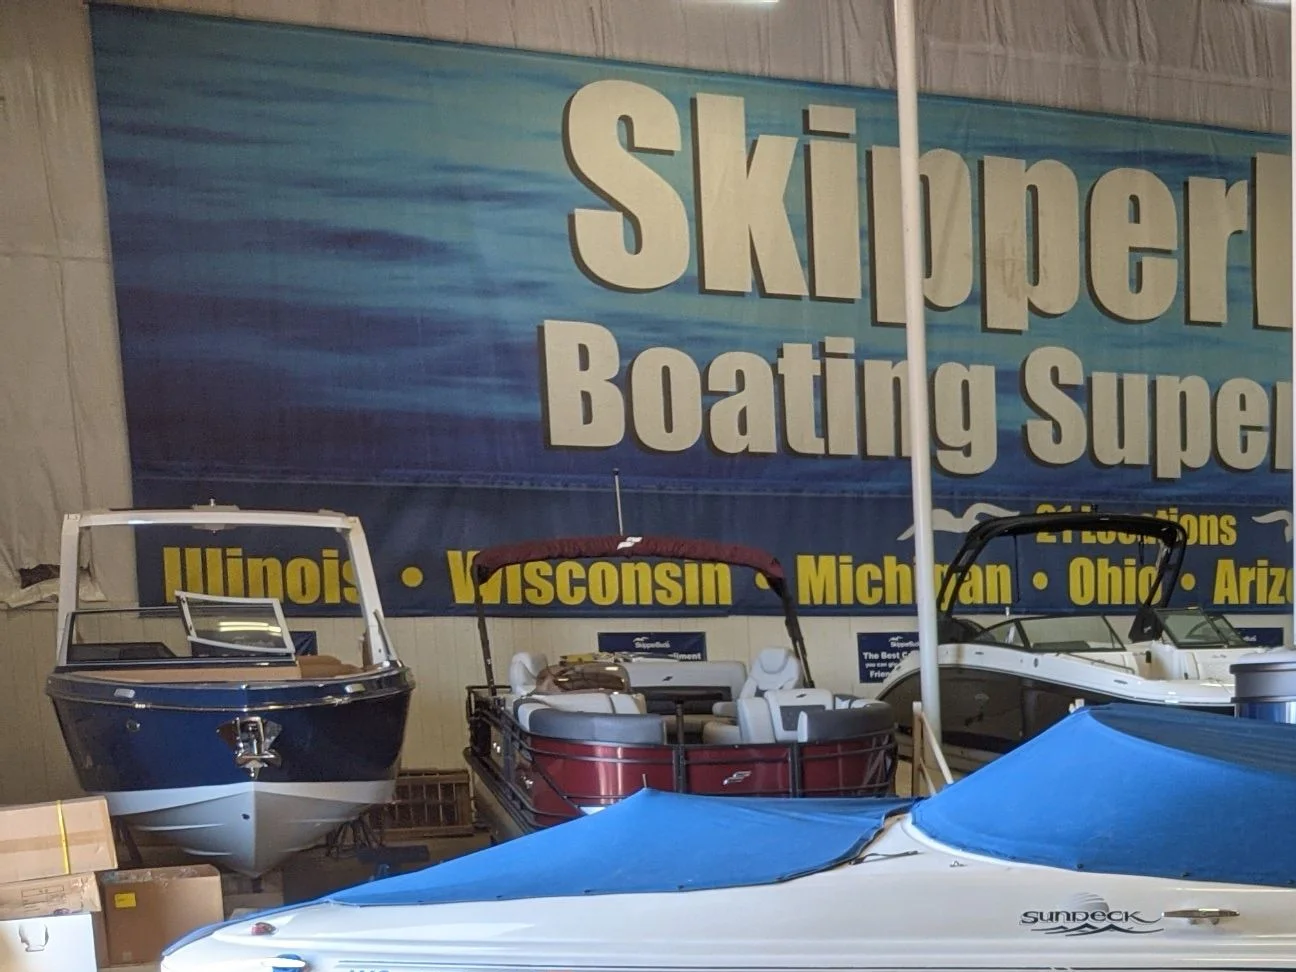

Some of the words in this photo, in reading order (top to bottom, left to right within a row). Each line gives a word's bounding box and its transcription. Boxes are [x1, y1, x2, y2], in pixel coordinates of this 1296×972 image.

[543, 320, 997, 474] Boating
[447, 550, 733, 605] Wisconsin
[797, 555, 1012, 611] Michgan
